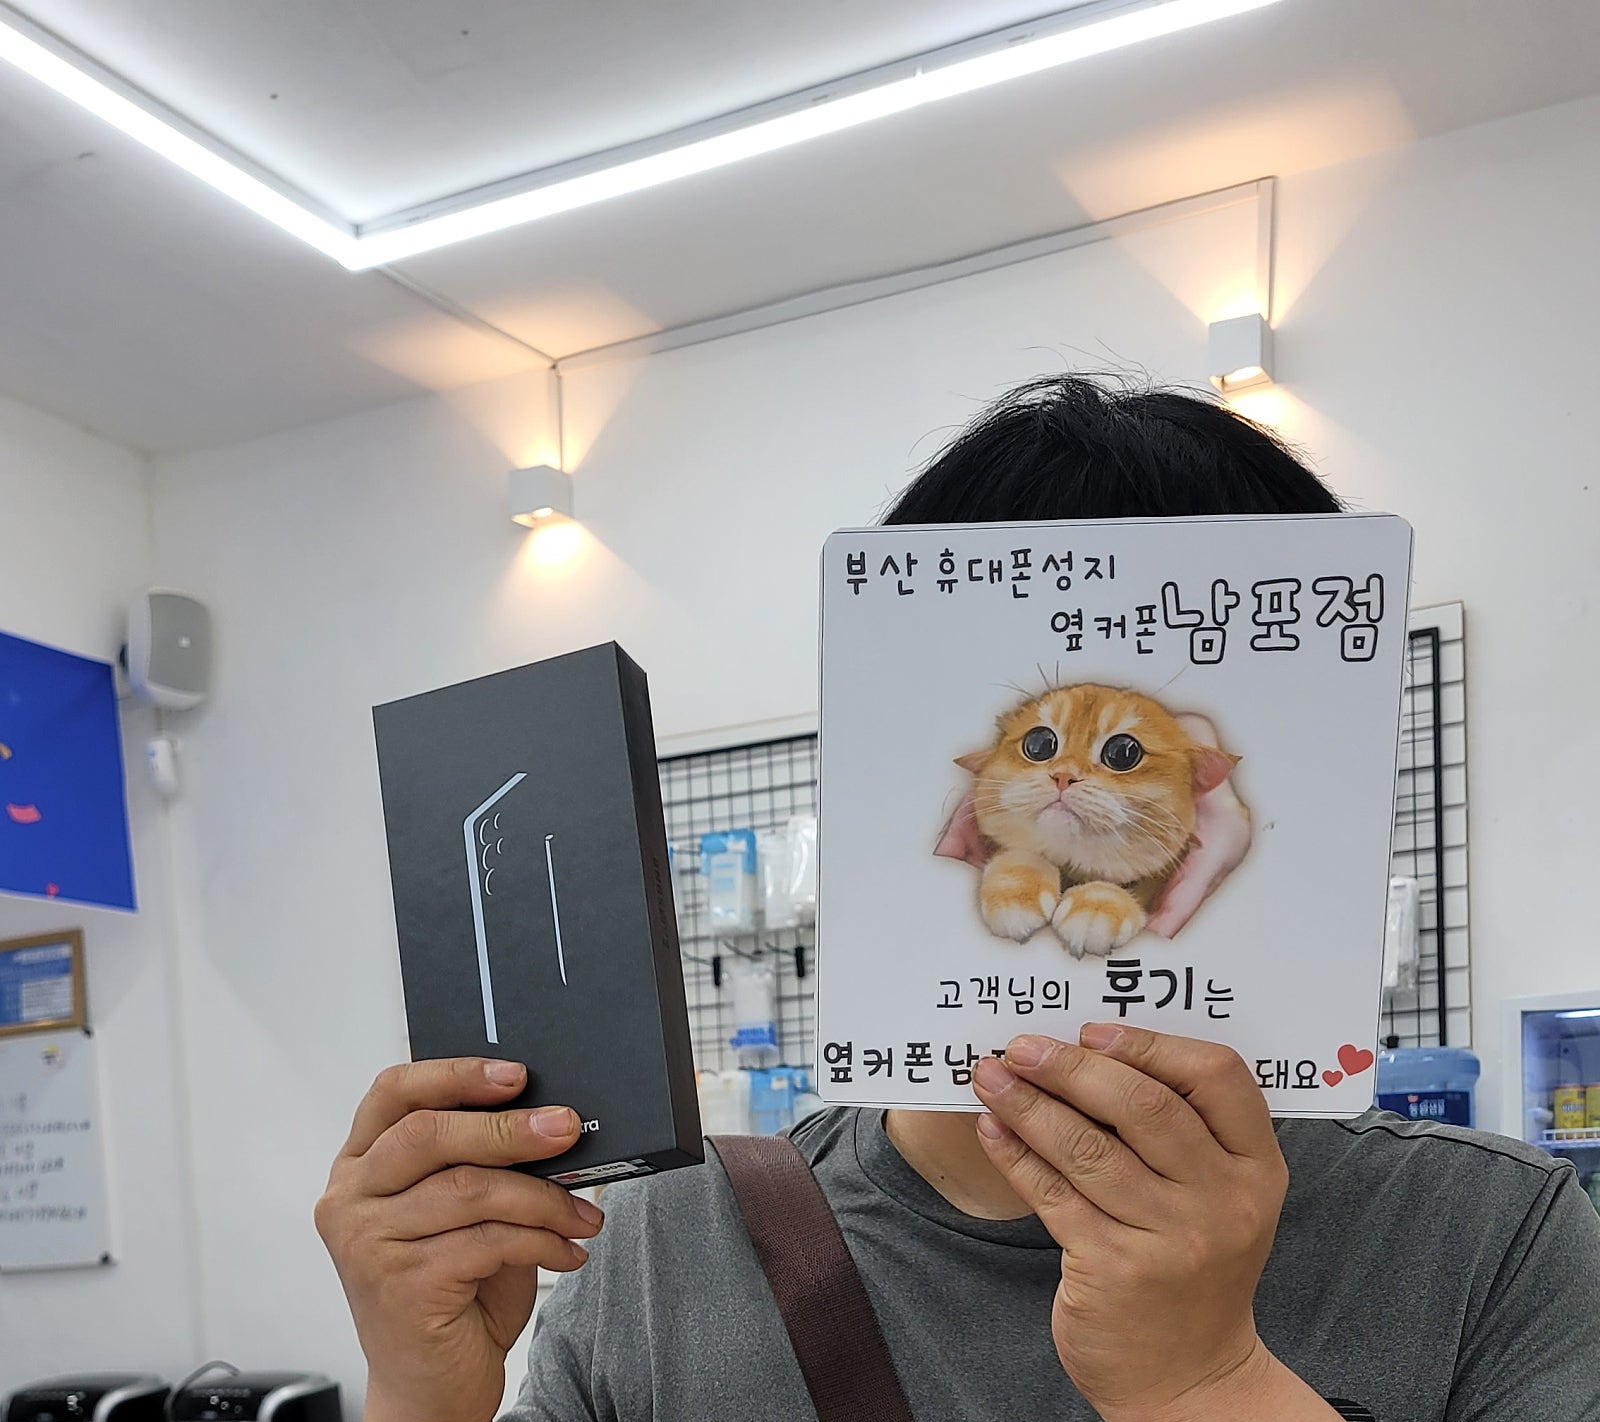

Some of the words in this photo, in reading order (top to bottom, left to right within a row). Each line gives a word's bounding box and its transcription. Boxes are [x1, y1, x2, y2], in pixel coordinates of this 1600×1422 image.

[846, 551, 919, 597] 부산
[936, 547, 1116, 598] 휴대폰성지
[1161, 573, 1384, 665] 남포점
[936, 976, 1071, 1015] 고객님의
[1101, 959, 1235, 1019] 후기는
[823, 1041, 1007, 1086] 옆커폰남
[1256, 1058, 1320, 1091] 돼요
[580, 1118, 600, 1134] tra
